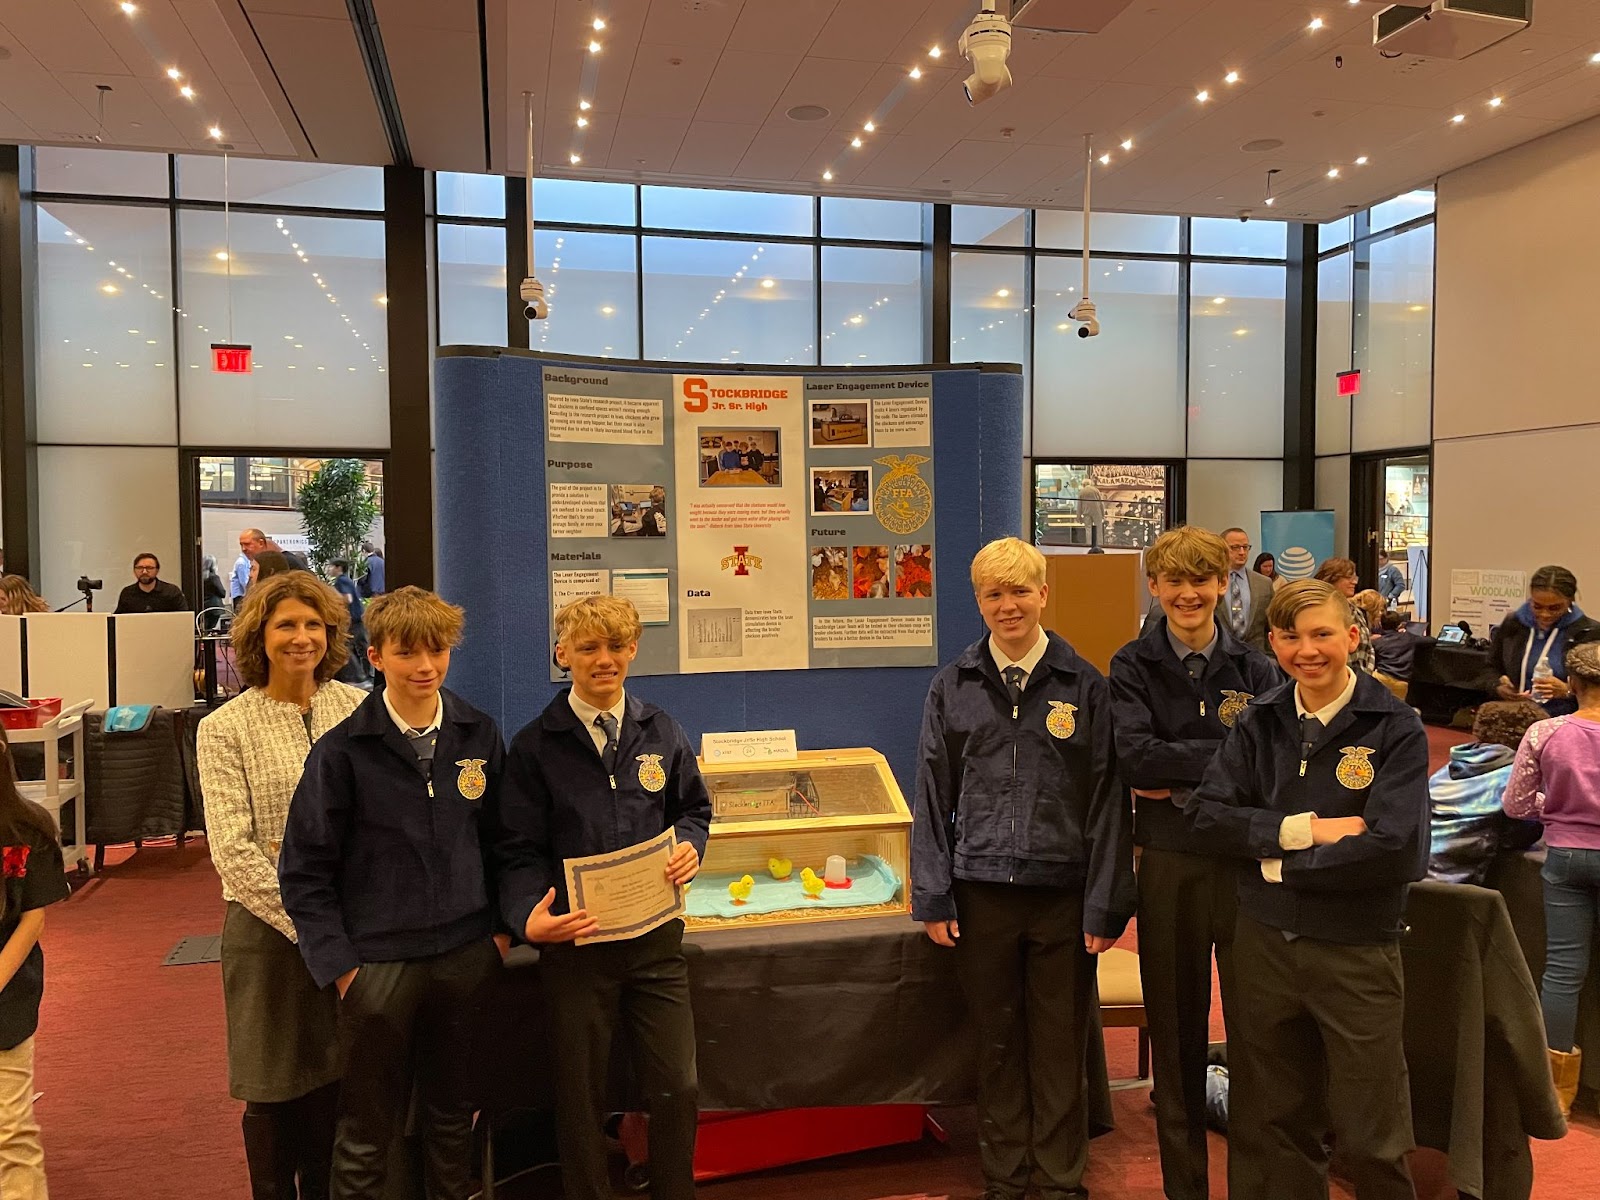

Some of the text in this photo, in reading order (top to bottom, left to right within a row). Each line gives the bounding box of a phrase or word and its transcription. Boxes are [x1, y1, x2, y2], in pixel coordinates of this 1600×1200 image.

[545, 374, 608, 386] Background
[836, 382, 895, 391] Engagement
[746, 402, 768, 412] High
[548, 460, 593, 470] Purpose
[892, 489, 914, 498] FFA
[551, 552, 602, 560] Materials
[720, 554, 762, 570] STATE
[1482, 574, 1520, 585] CENTRAL
[1470, 586, 1522, 598] WOODLAND
